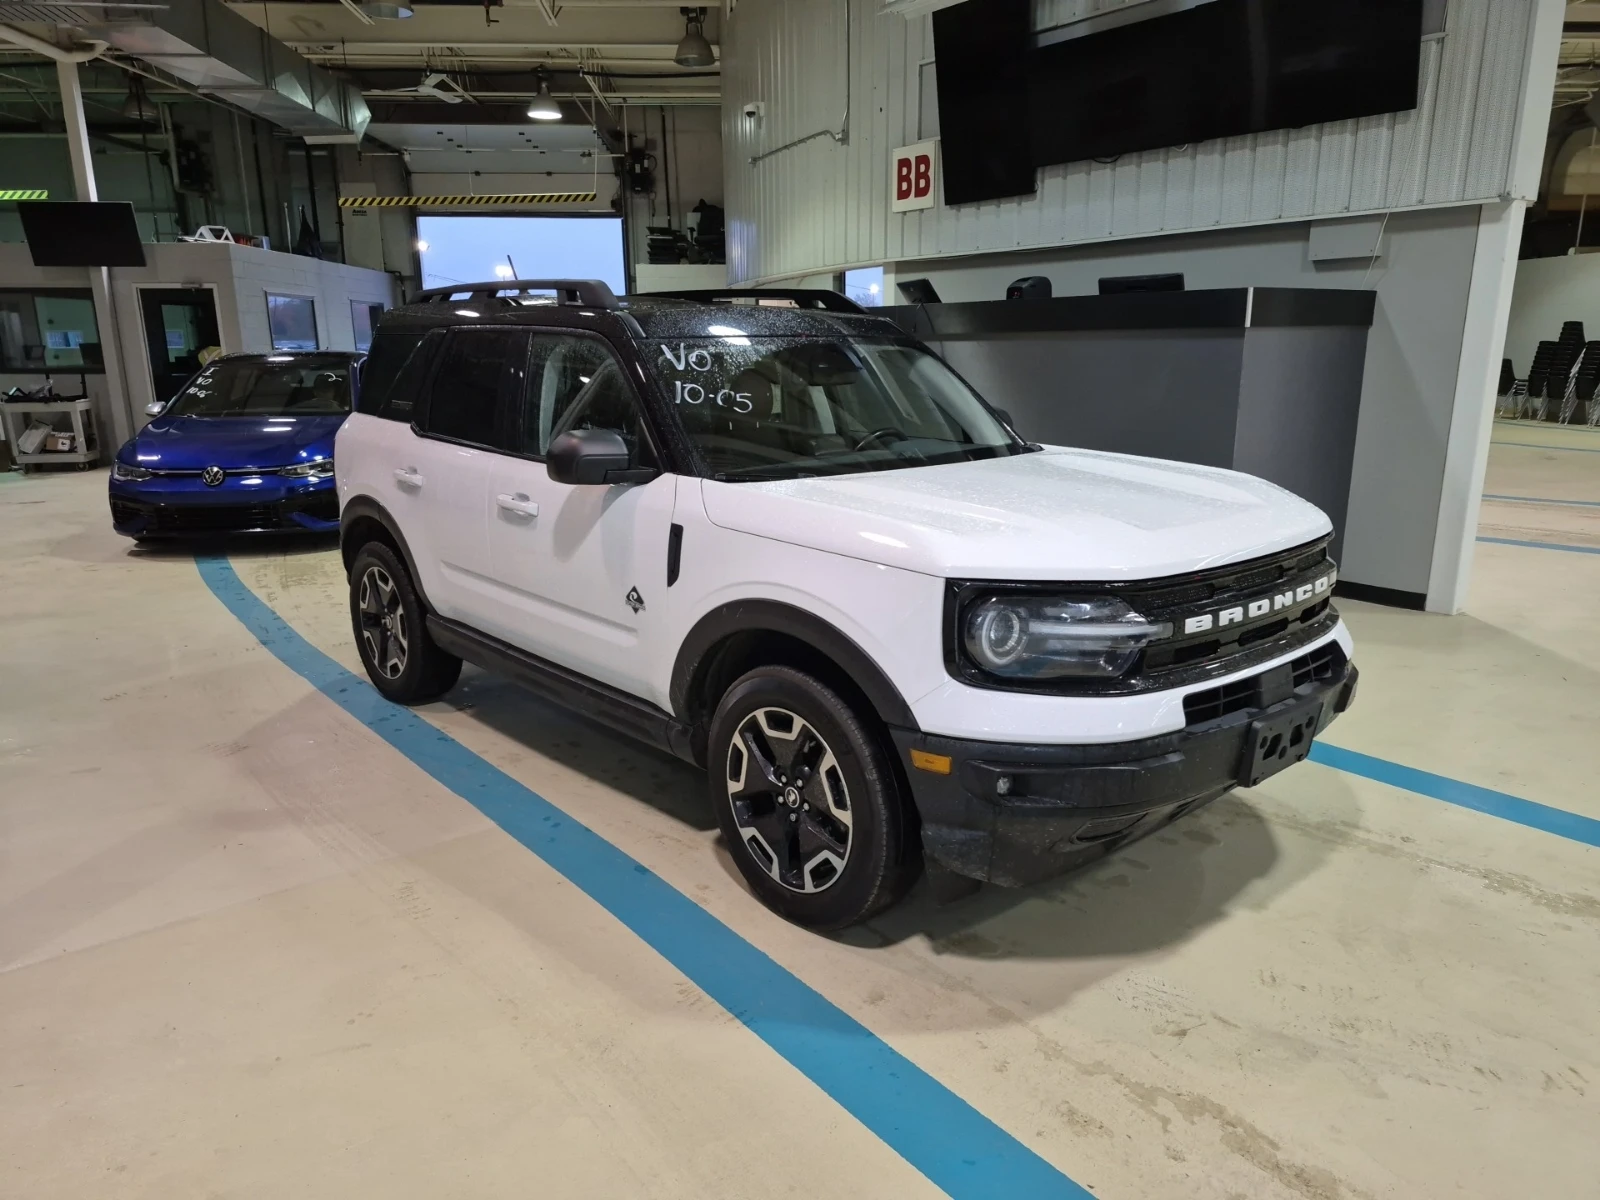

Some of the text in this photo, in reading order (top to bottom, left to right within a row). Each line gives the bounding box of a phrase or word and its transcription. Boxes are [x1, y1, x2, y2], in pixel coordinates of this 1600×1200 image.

[897, 154, 931, 200] BB
[661, 343, 711, 371] VO
[1184, 576, 1328, 634] BRONCO
